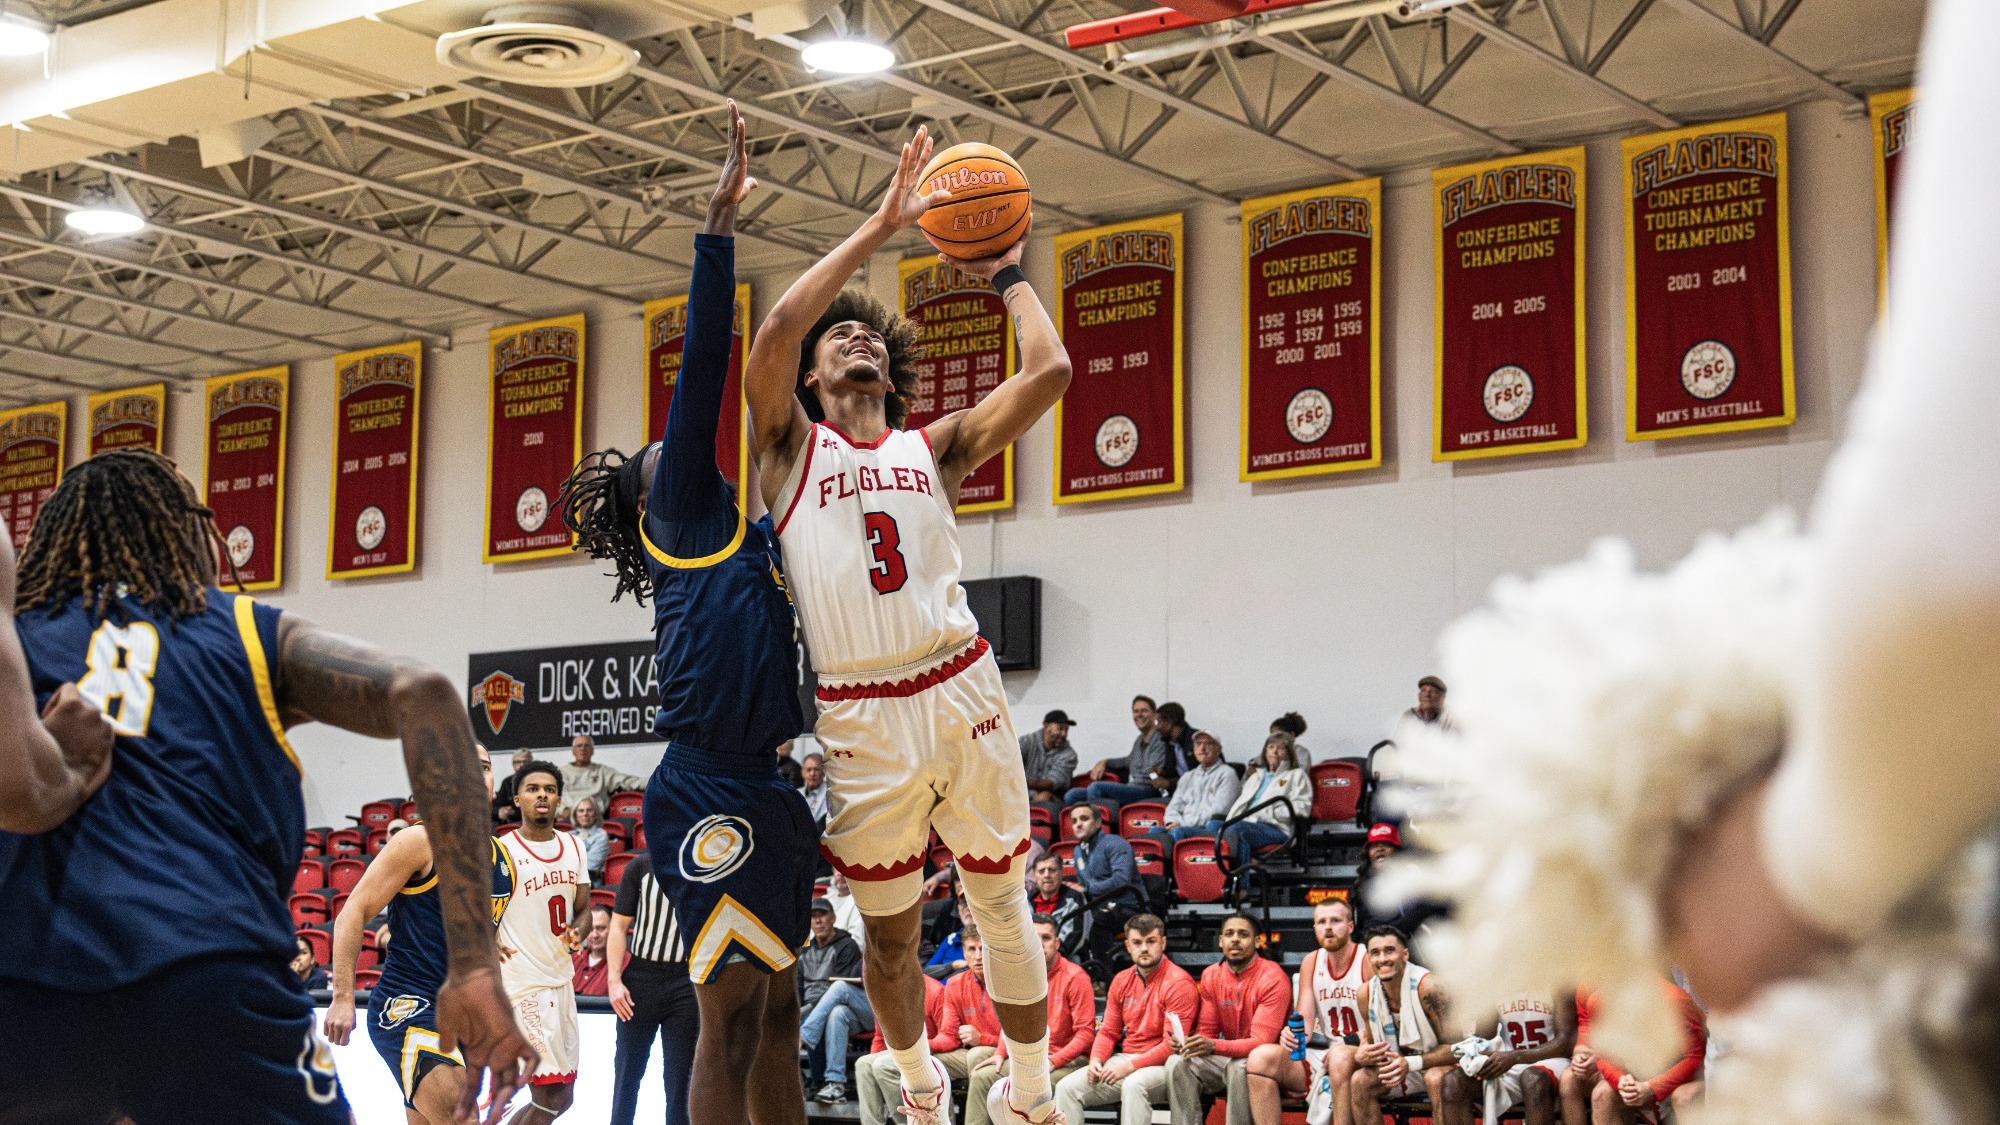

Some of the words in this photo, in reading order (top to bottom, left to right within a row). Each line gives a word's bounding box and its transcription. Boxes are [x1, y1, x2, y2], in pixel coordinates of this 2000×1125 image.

[929, 167, 1008, 192] Wilson
[1635, 137, 1774, 194] FLAGLER
[1445, 168, 1573, 224] FLAGLER
[1648, 177, 1761, 209] CONFERENCE
[1252, 199, 1369, 252] FLAGLER
[1645, 198, 1766, 231] TOURNAMENT
[1456, 217, 1561, 248] CONFERENCE
[1655, 222, 1756, 251] CHAMPIONS
[1064, 232, 1173, 286] FLAGLER
[1262, 248, 1358, 278] CONFERENCE
[1461, 240, 1555, 268] CHAMPIONS
[1268, 269, 1352, 297] CHAMPIONS
[1667, 272, 1700, 292] 2003
[1713, 265, 1747, 286] 2004
[1075, 280, 1162, 308] CONFERENCE
[1472, 302, 1503, 320] 2004
[1513, 296, 1546, 314] 2005
[924, 298, 988, 322] NATIONAL
[1079, 300, 1157, 327] CHAMPIONS
[917, 314, 1002, 341] HAMPIONSHIP
[496, 330, 577, 373] FLAGLER
[1275, 347, 1304, 365] 2000
[1314, 342, 1342, 360] 2001
[341, 355, 414, 398] FLAGLER
[502, 362, 568, 385] CONFERENCE
[1694, 359, 1725, 383] FSC
[501, 378, 571, 402] TOURNAMENT
[1495, 383, 1524, 406] FSC
[505, 396, 564, 418] CHAMPIONS
[1297, 405, 1324, 427] FSC
[1656, 408, 1689, 424] MEN'S
[1693, 400, 1763, 419] BASKETBALL
[1105, 432, 1130, 452] FSC
[1459, 430, 1490, 445] MEN'S
[1493, 423, 1558, 441] BASKETBALL
[819, 465, 933, 509] FLGLER
[863, 510, 909, 595] 3
[76, 620, 159, 737] 8
[539, 658, 595, 704] DICK
[602, 657, 622, 700] &
[629, 653, 660, 698] KA
[561, 706, 641, 738] RESERVED
[971, 713, 1002, 740] PBC
[548, 894, 567, 937] 0
[1328, 1006, 1359, 1037] 10
[1507, 1019, 1549, 1050] 25
